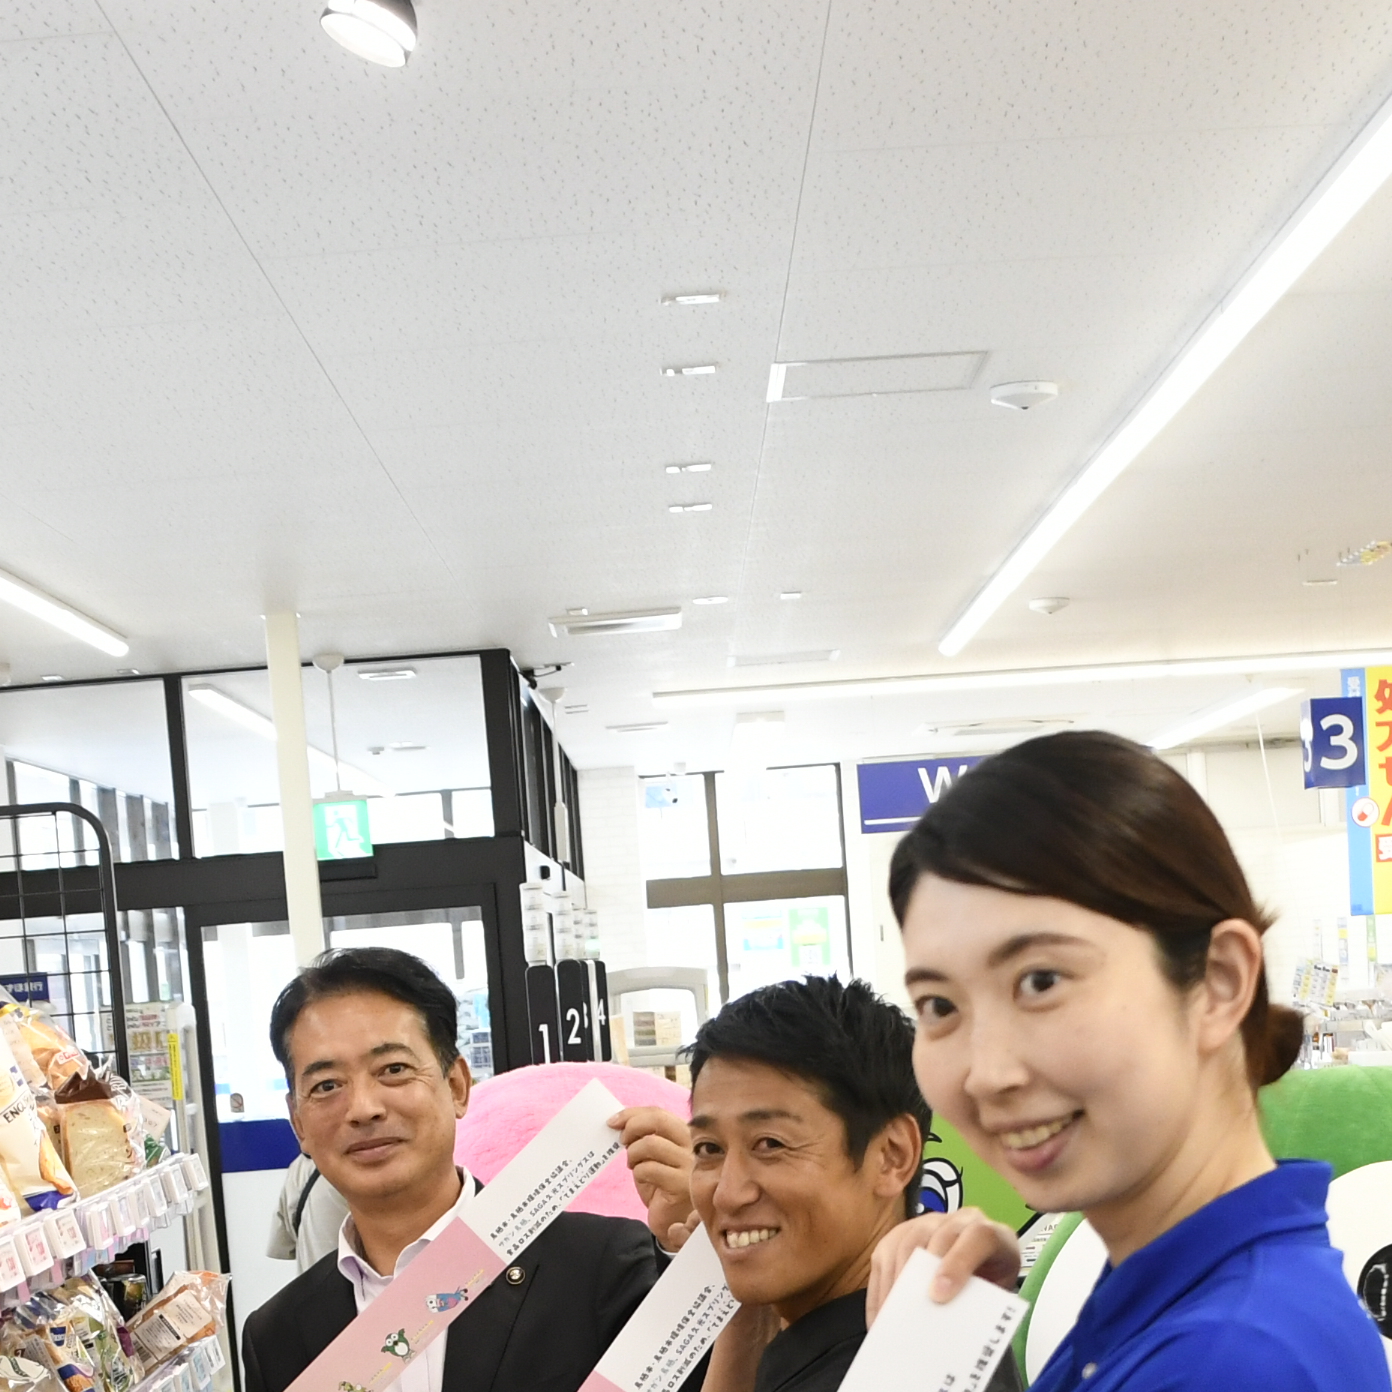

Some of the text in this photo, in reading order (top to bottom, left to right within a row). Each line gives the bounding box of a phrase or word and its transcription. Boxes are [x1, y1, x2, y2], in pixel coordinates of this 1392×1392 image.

[1320, 714, 1358, 771] 3
[538, 1023, 550, 1063] 1
[566, 1008, 582, 1045] 2
